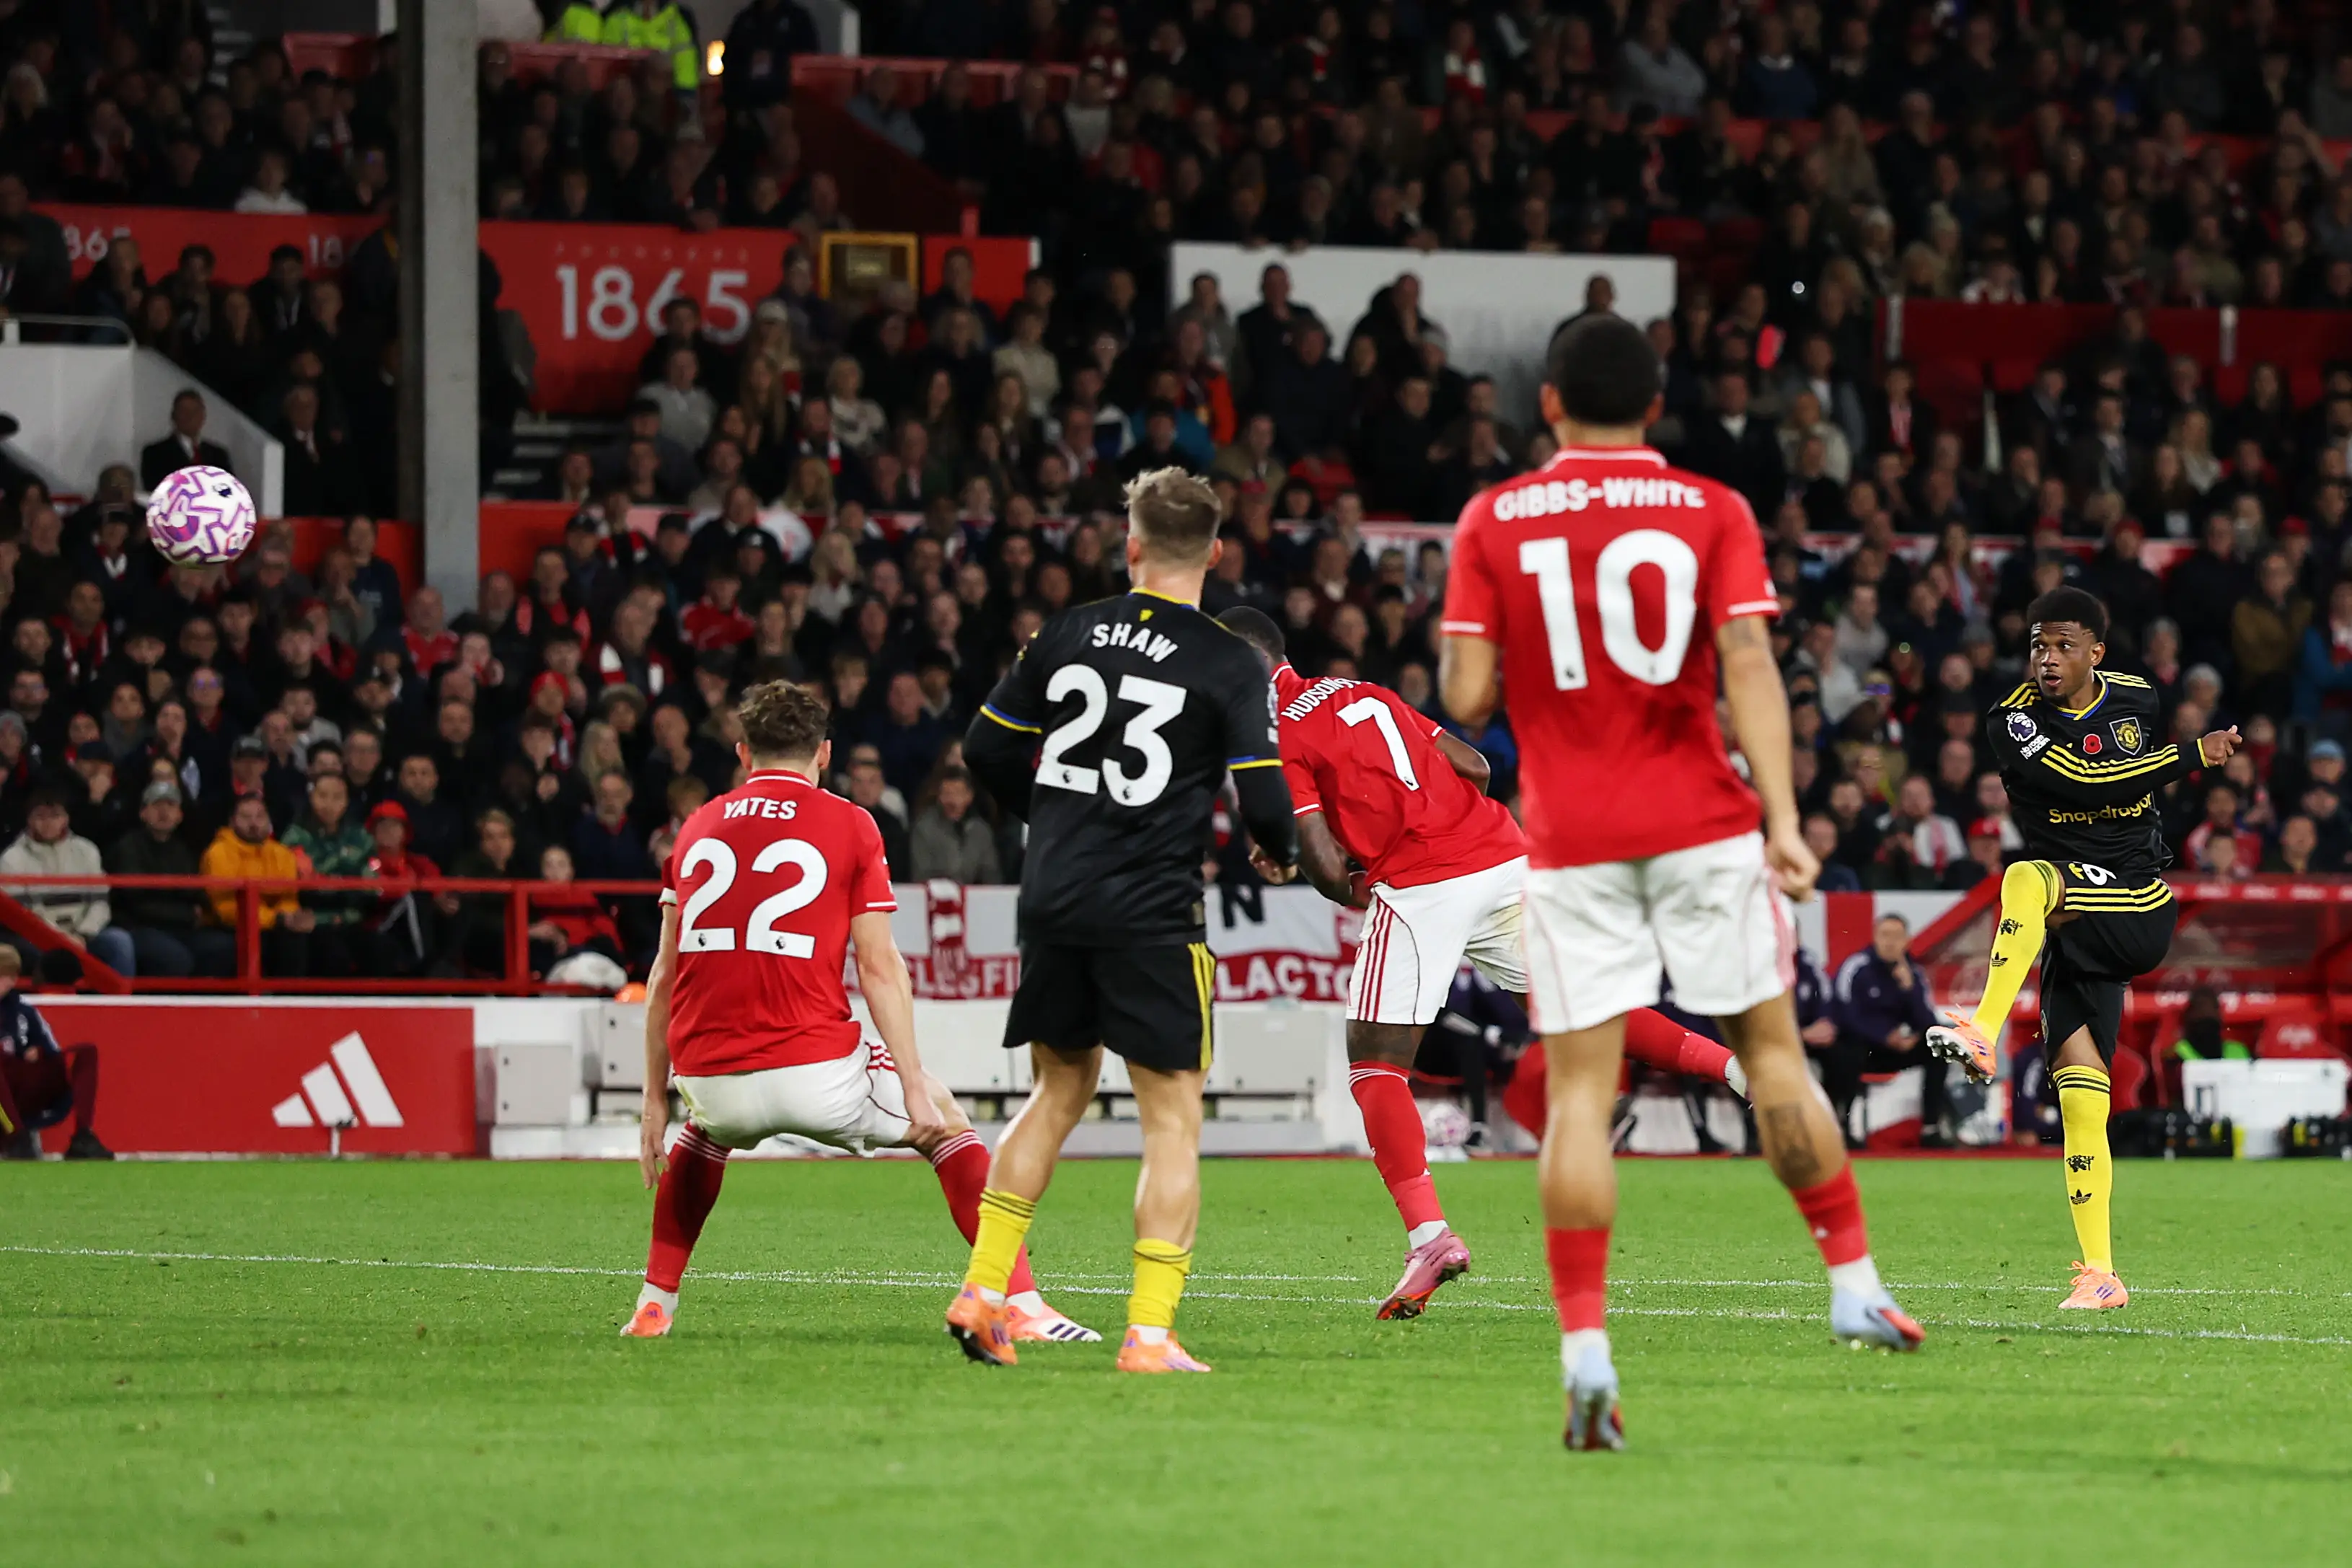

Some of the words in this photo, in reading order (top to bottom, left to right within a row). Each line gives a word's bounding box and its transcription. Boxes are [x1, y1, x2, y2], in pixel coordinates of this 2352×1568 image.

[555, 264, 751, 344] 1865
[1494, 477, 1706, 521] GIBBS-WHITE
[1092, 622, 1179, 663] SHAW
[1519, 528, 1699, 691] 10
[1034, 663, 1187, 807] 23
[1336, 696, 1420, 791] 7
[723, 796, 798, 820] YATES
[678, 837, 828, 959] 22
